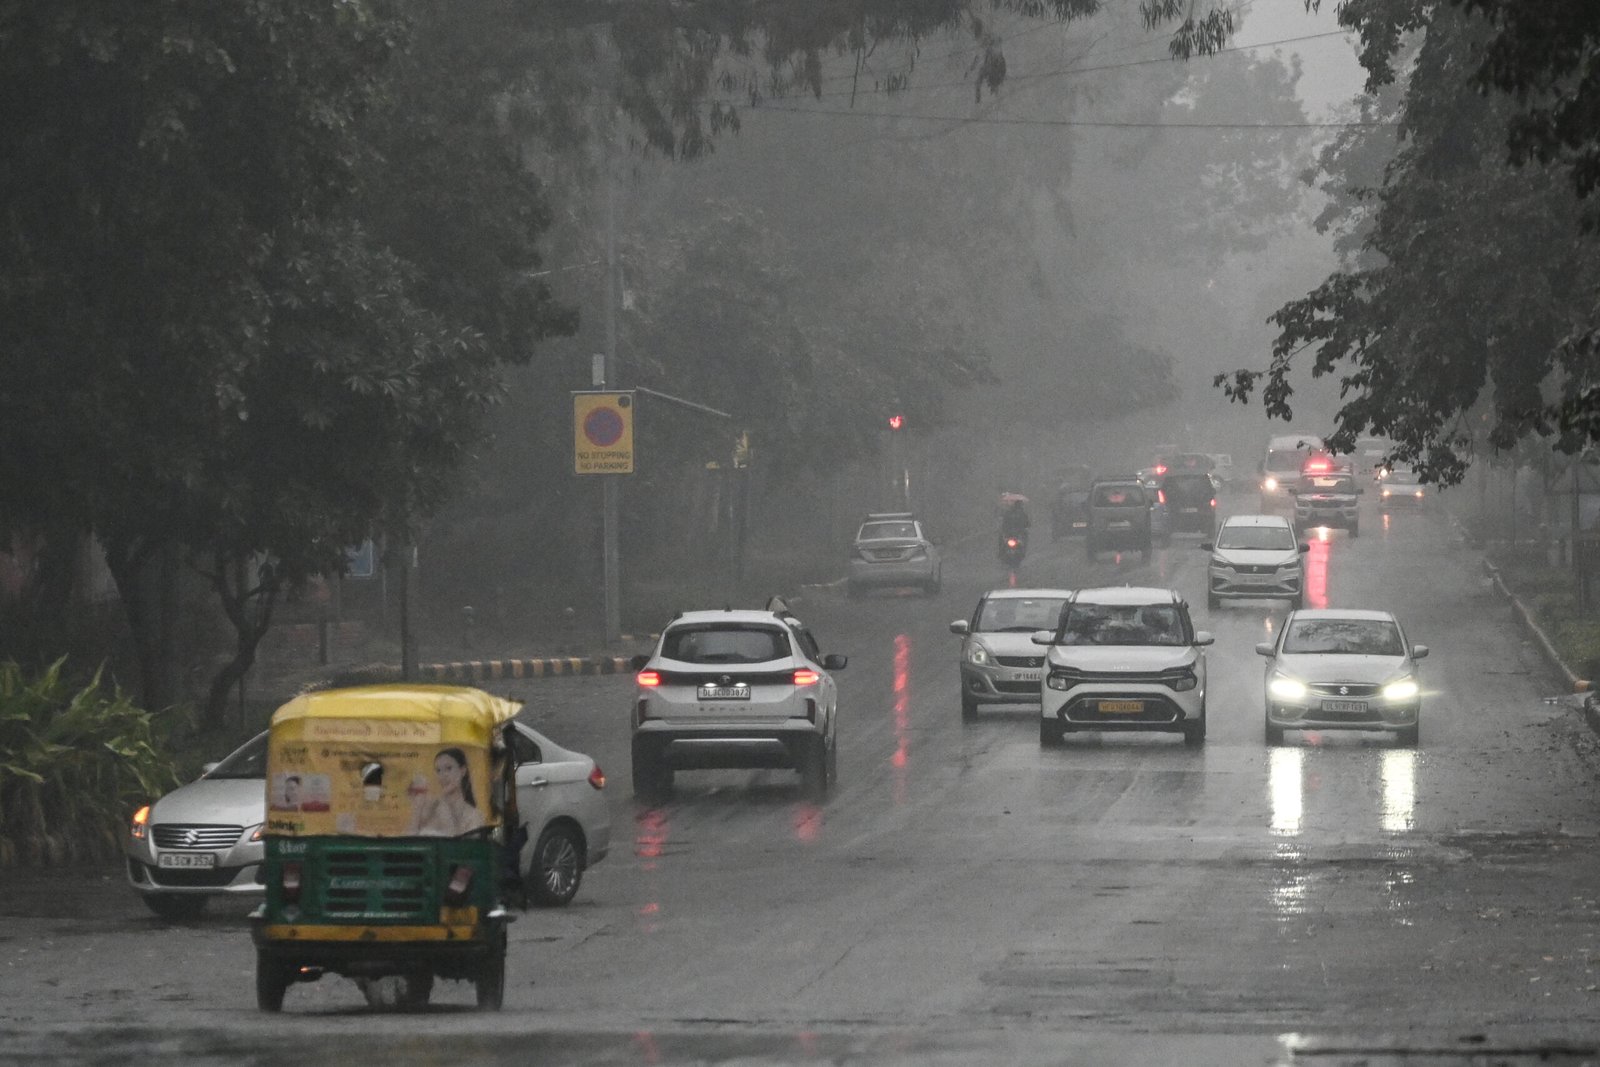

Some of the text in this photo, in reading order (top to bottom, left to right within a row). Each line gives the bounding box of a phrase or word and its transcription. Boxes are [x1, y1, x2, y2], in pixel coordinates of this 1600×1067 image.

[577, 451, 631, 459] NO STOPPING
[581, 462, 629, 470] NO PARKING
